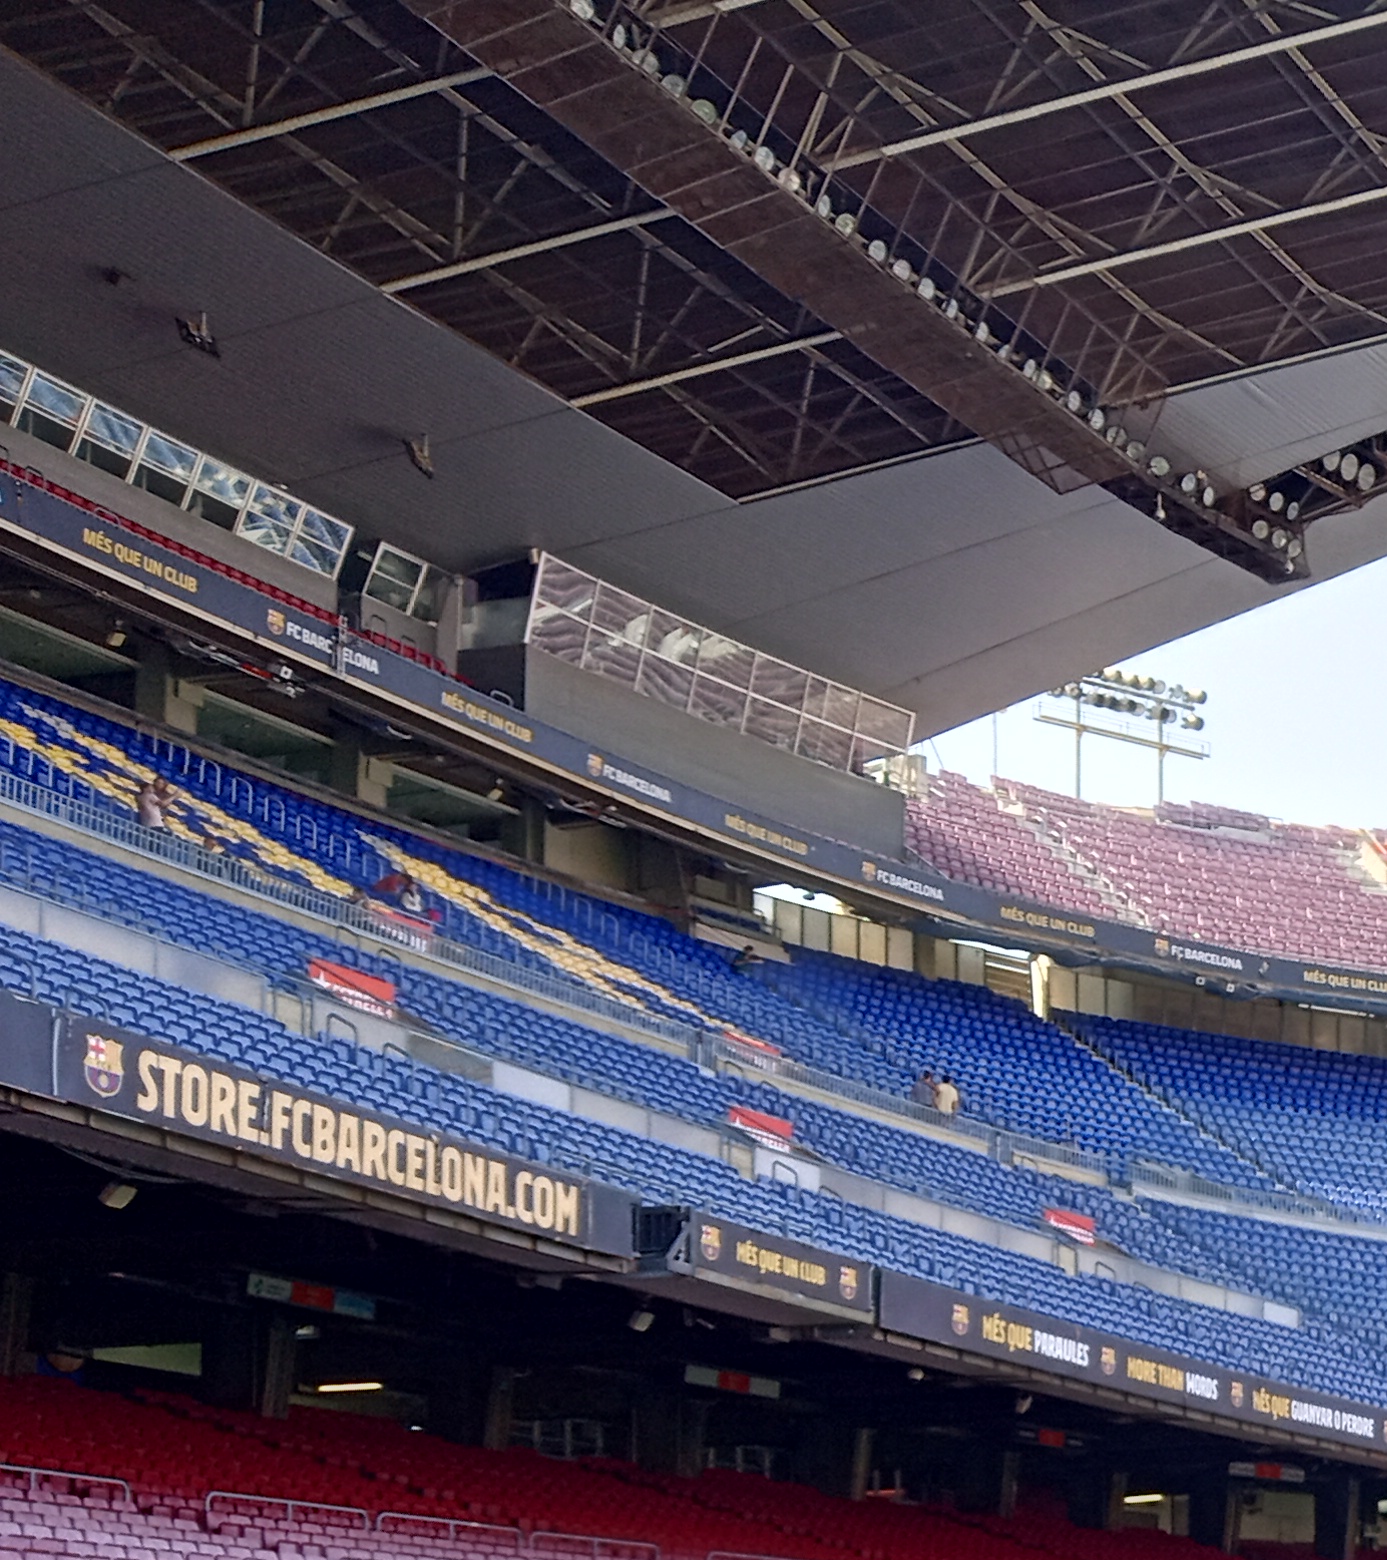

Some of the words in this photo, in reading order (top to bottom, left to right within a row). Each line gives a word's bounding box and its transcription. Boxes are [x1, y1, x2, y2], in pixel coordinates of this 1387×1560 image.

[84, 528, 112, 553] MÉS
[115, 542, 141, 568] QUE
[144, 554, 163, 577] UN
[163, 564, 198, 593] CLUB
[286, 621, 302, 641] FC
[302, 628, 380, 675] BARCELONA
[1001, 906, 1024, 921] MÉS
[1026, 911, 1049, 927] QUE
[1050, 918, 1068, 931] UN
[1069, 921, 1095, 937] CLUB
[1172, 945, 1185, 957] FC
[1186, 947, 1242, 970] BARCELONA
[1304, 969, 1326, 984] MÉS
[1328, 974, 1349, 988] QUE
[1351, 979, 1367, 990] UN
[137, 1049, 578, 1237] STORE.FCBARCELONA.COM
[982, 1313, 1007, 1344] MÉS
[1007, 1323, 1032, 1352] QUE
[1033, 1330, 1090, 1367] PARAULES
[1127, 1356, 1157, 1384] MORE
[1158, 1363, 1184, 1391] THAN
